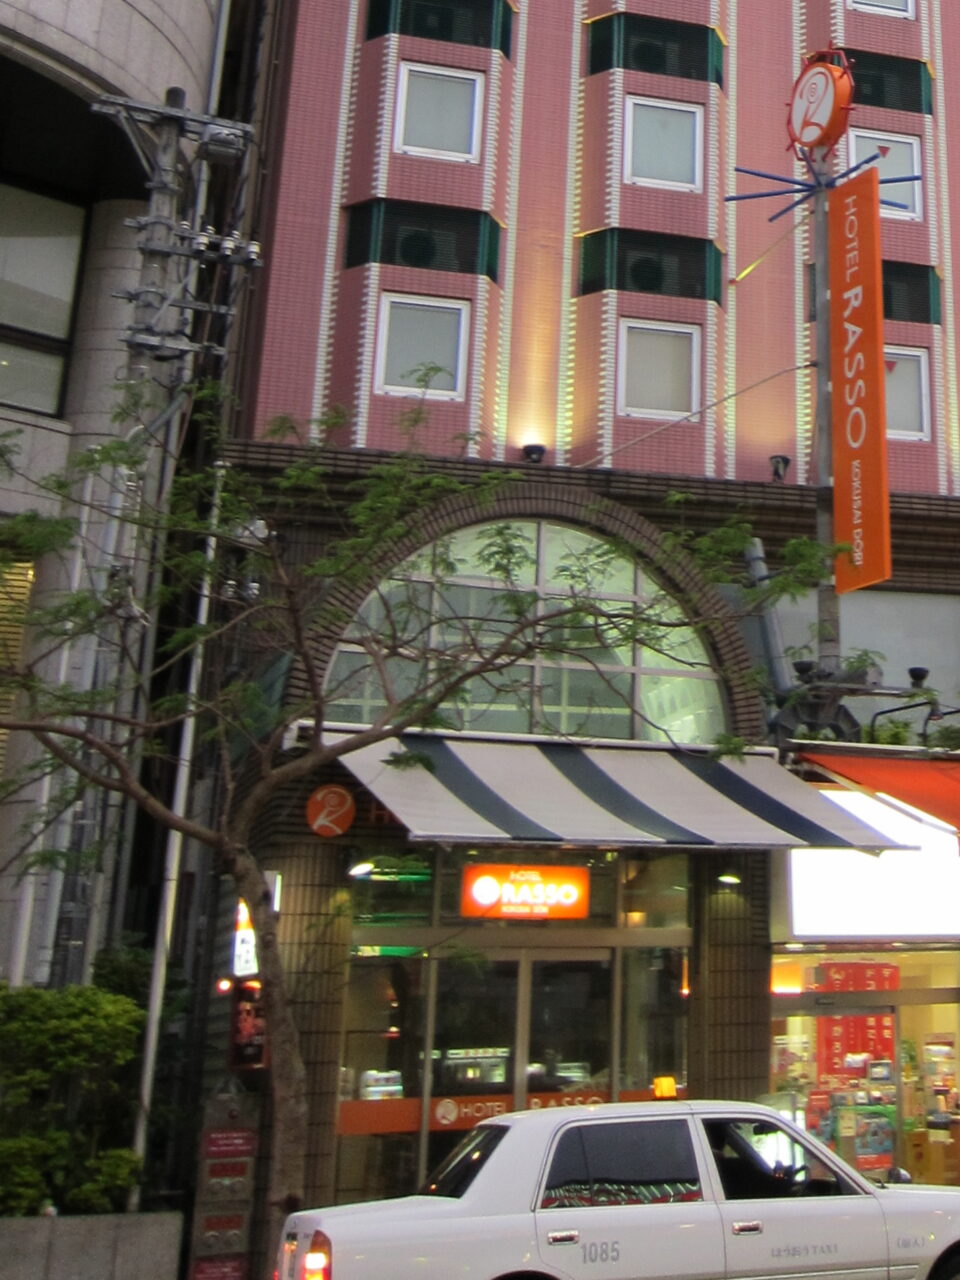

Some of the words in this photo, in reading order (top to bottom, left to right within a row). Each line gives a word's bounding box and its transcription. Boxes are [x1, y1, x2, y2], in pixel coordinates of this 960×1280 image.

[844, 195, 859, 283] HOTEL
[843, 285, 866, 449] RASSO
[501, 883, 578, 905] RASSO
[581, 1241, 619, 1264] 1085
